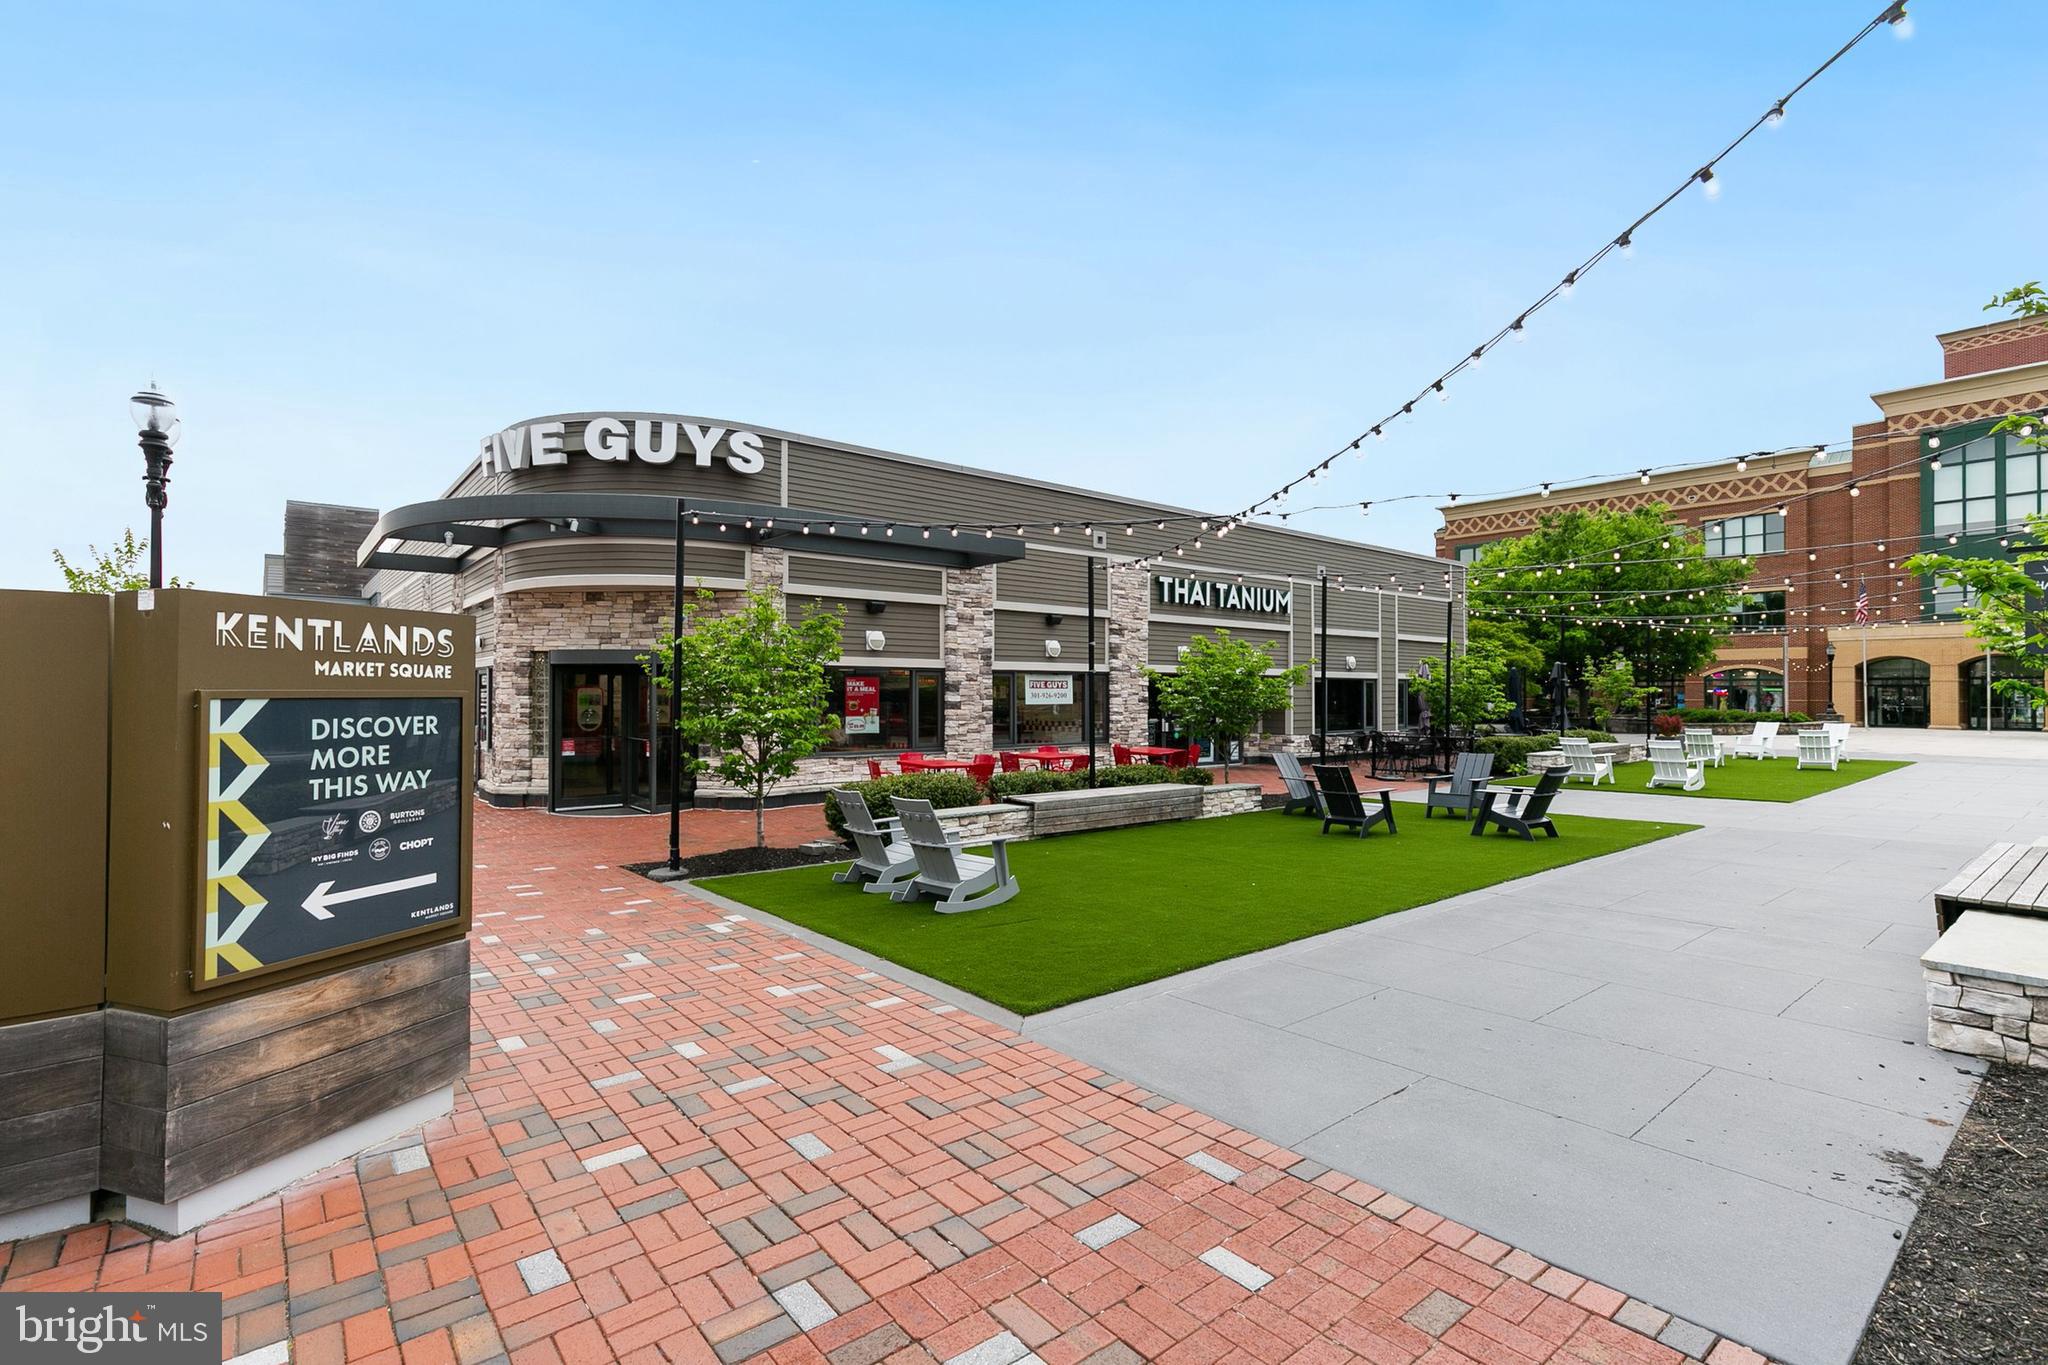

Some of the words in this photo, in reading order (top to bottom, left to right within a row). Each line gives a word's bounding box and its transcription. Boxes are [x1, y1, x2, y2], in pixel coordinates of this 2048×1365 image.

[481, 421, 568, 477] FIVE
[583, 417, 765, 474] GUYS
[216, 611, 455, 658] KENTLANDS
[315, 660, 385, 677] MARKET
[390, 662, 452, 679] SQUARE
[1030, 681, 1046, 689] FIVE
[1047, 681, 1068, 689] GUYS
[312, 715, 439, 741] DISCOVER
[310, 745, 390, 771] MORE
[309, 774, 368, 800] THIS
[375, 769, 432, 793] WAY
[390, 808, 425, 820] BURTONS
[400, 837, 434, 851] CHOPT
[311, 855, 323, 863] MY
[323, 852, 336, 861] BIG
[337, 849, 359, 859] FINDS
[410, 902, 454, 919] KENTLANDS
